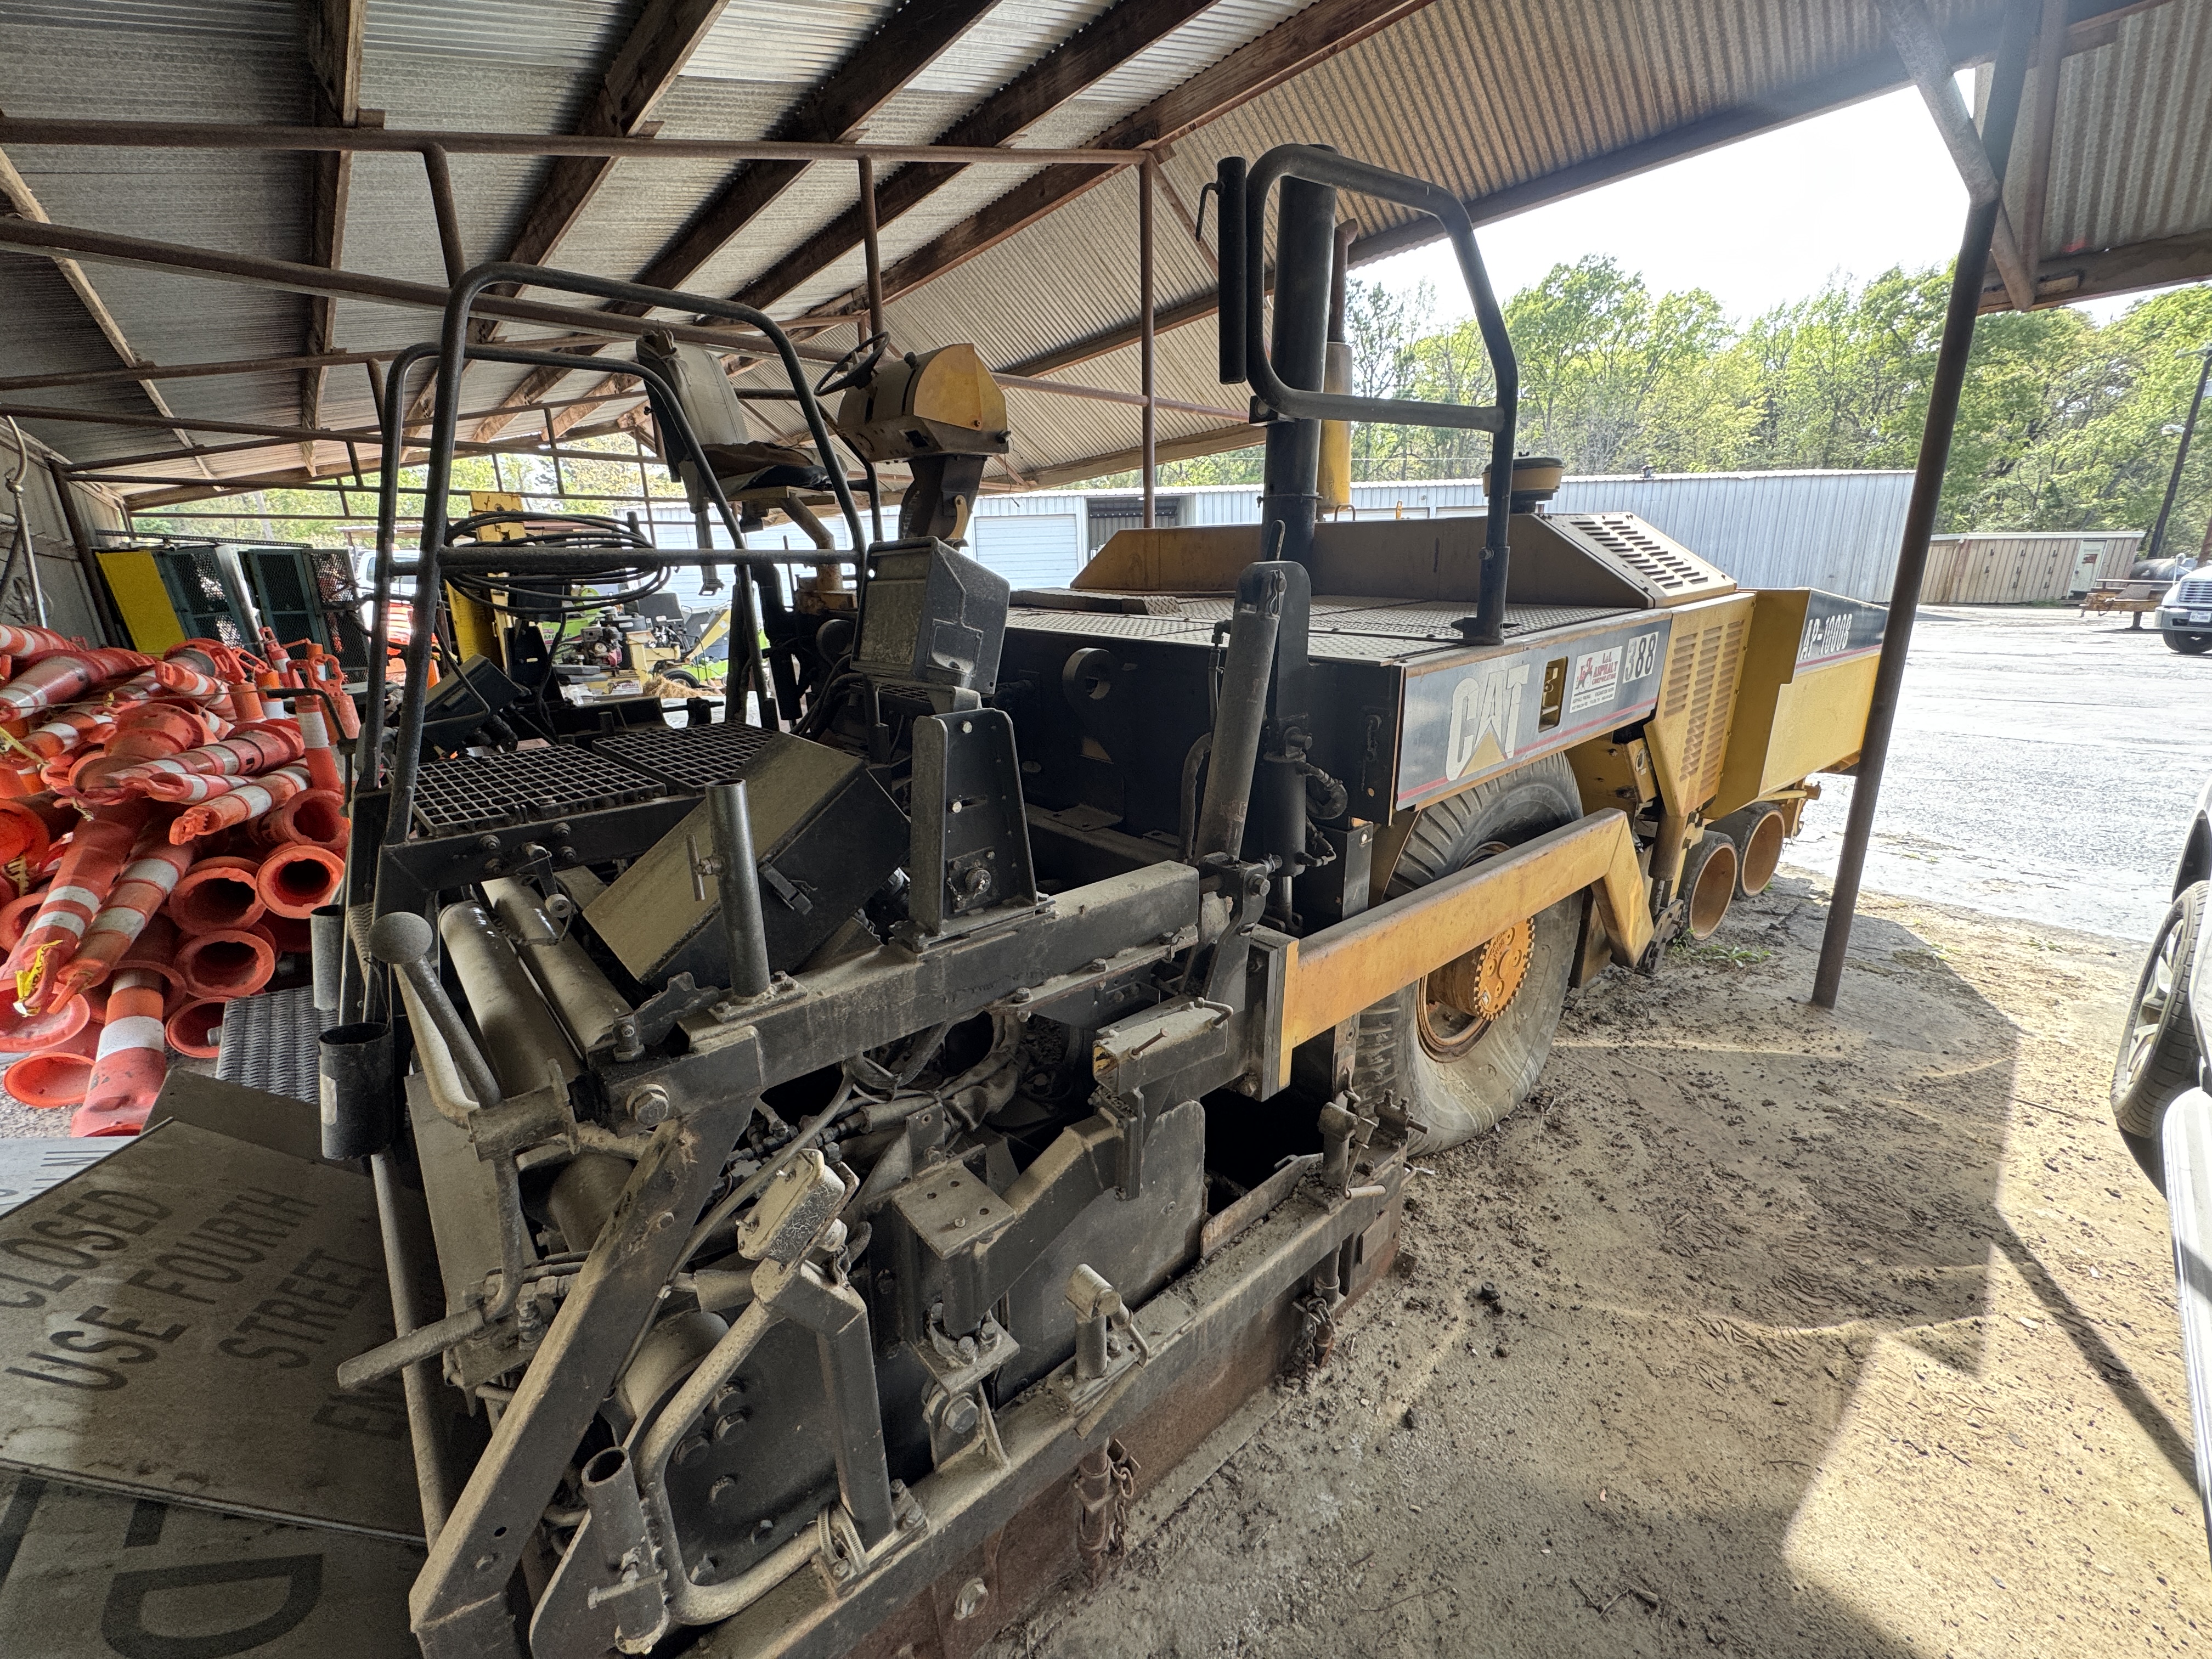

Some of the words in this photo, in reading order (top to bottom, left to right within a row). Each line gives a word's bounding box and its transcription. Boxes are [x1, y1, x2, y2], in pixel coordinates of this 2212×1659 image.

[1593, 661, 1618, 678] ASPHALT
[1624, 633, 1656, 681] 388
[1799, 613, 1853, 661] AP-1000B
[1446, 664, 1530, 781] CAT
[4, 1305, 189, 1391] USE
[126, 1186, 319, 1305] FOURTH
[218, 1246, 385, 1368] STREET
